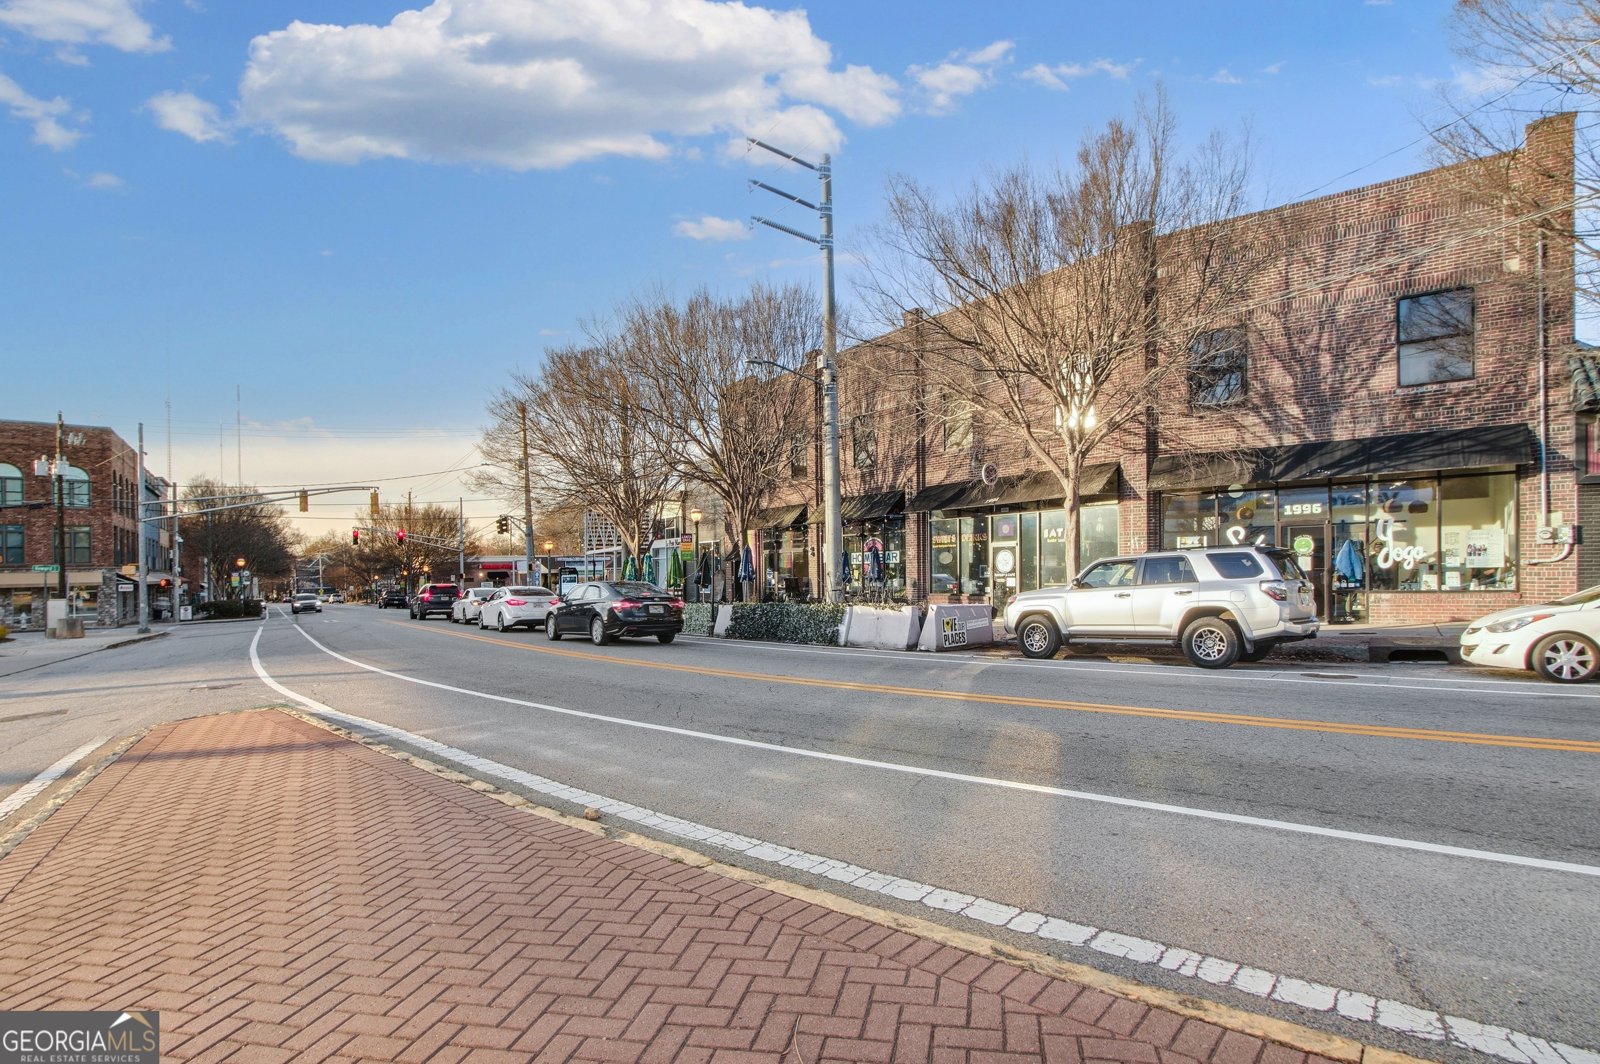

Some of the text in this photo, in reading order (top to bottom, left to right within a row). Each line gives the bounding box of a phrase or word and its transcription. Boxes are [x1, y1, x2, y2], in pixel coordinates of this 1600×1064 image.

[1284, 503, 1322, 515] 1996
[1376, 518, 1426, 570] Yoga
[944, 632, 966, 646] PLACES
